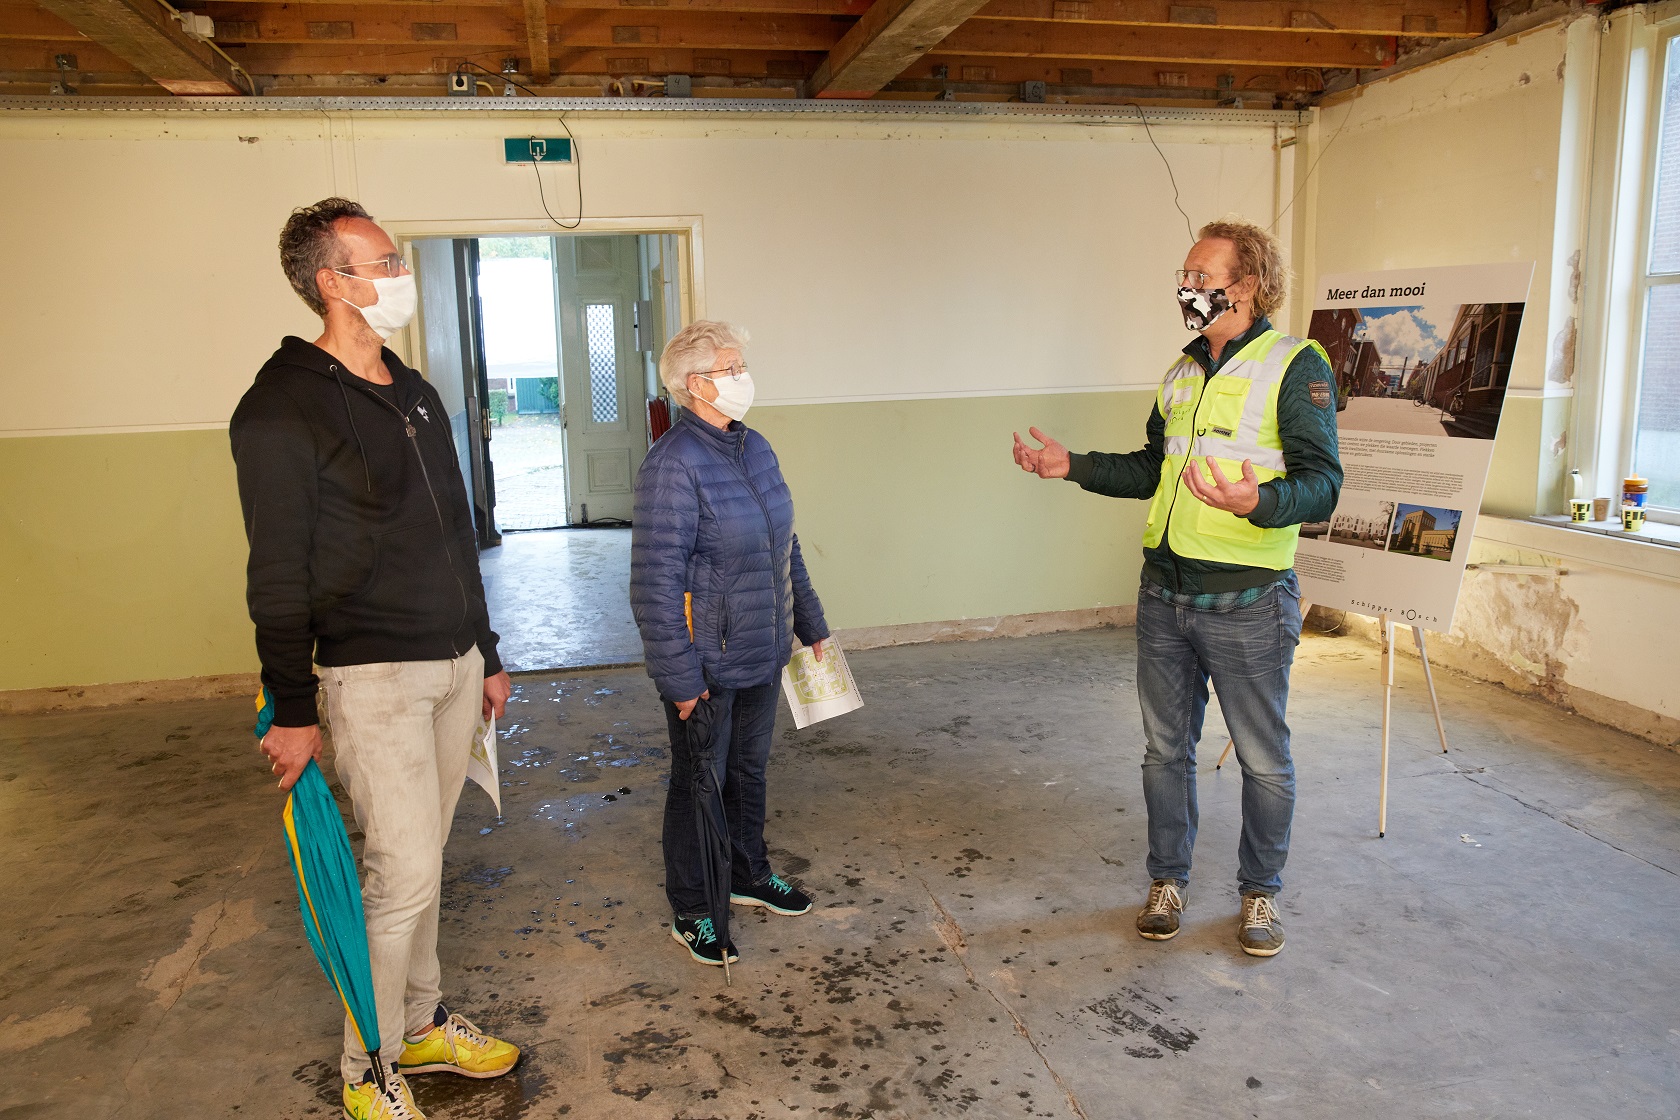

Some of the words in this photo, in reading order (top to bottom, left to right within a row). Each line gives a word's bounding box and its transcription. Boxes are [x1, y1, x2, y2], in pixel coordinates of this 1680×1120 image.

[1326, 288, 1359, 301] Meer
[1361, 285, 1386, 299] dan
[1389, 282, 1426, 297] mooi
[1351, 599, 1393, 613] Schipper
